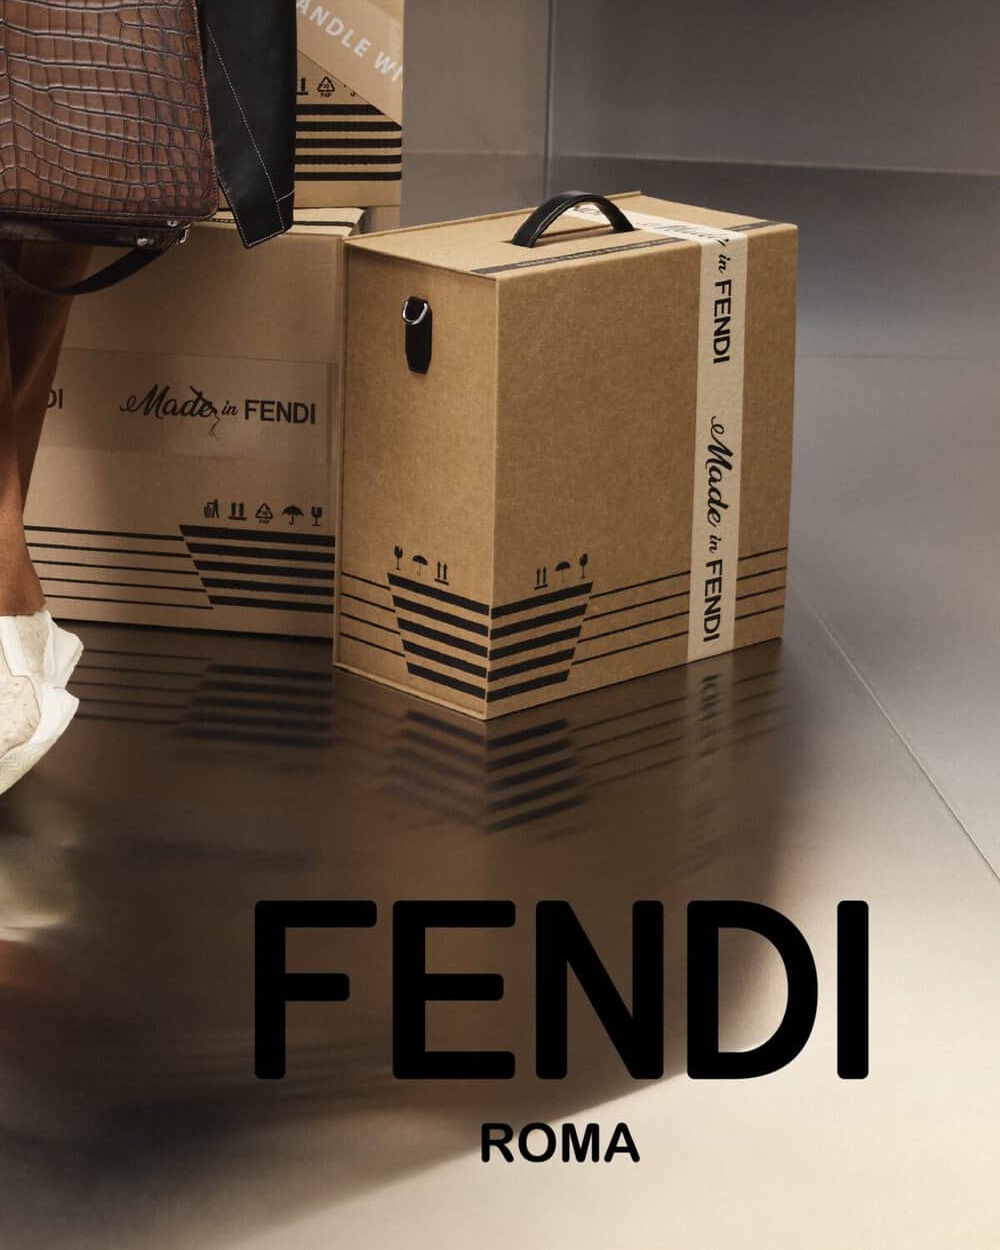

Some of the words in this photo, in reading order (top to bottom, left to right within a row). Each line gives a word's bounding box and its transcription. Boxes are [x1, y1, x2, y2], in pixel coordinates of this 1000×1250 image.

[717, 254, 731, 274] in
[713, 279, 732, 364] FENDI
[118, 383, 218, 419] Made
[220, 400, 240, 417] in
[244, 400, 316, 425] FENDI
[704, 415, 734, 527] Made
[708, 534, 723, 554] in
[703, 559, 724, 643] FENDI
